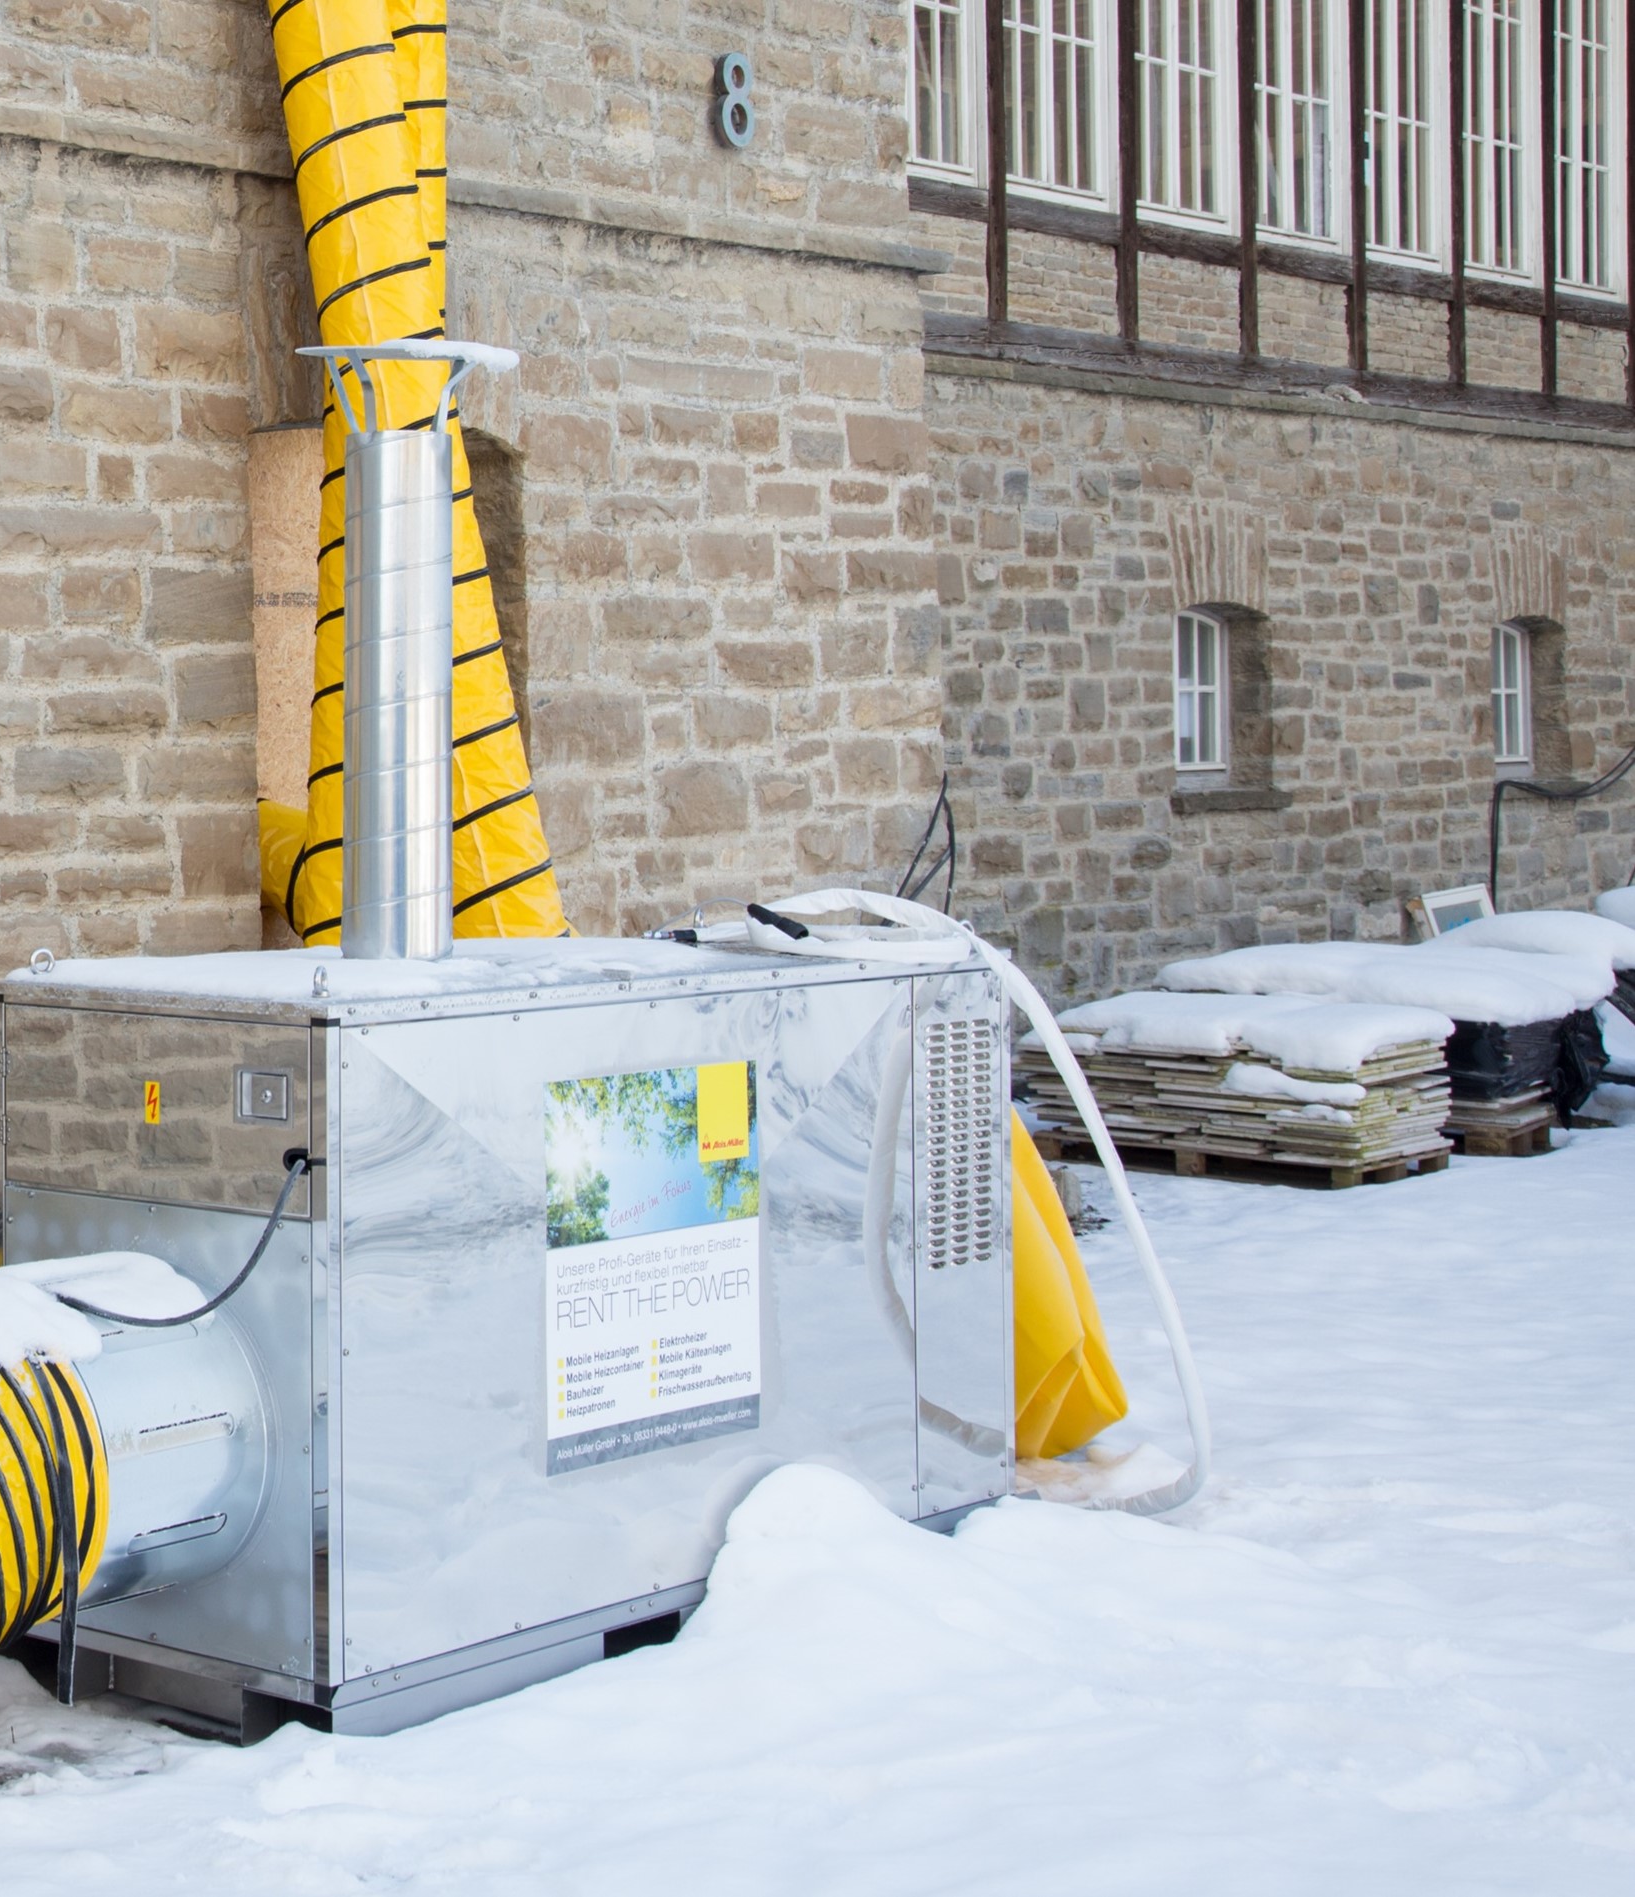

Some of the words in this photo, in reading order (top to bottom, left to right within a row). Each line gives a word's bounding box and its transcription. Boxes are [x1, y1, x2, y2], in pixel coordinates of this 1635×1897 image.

[720, 52, 756, 148] 8
[610, 1204, 647, 1229] Energie
[647, 1195, 660, 1210] im
[661, 1179, 692, 1202] Fokus
[556, 1263, 596, 1279] Unsere
[598, 1249, 662, 1273] Profi-Geräte
[663, 1245, 678, 1260] für
[679, 1242, 706, 1257] Ihren
[707, 1236, 742, 1254] Einsatz
[556, 1276, 609, 1298] kurzfristig
[611, 1271, 632, 1288] und
[634, 1265, 670, 1283] flexibel
[671, 1258, 709, 1276] mietbar
[556, 1291, 619, 1331] RENT
[622, 1283, 668, 1318] THE
[672, 1267, 751, 1310] POWER
[659, 1331, 708, 1349] Elektroheizer
[565, 1353, 593, 1368] Mobile
[593, 1344, 640, 1363] Heizanlagen
[658, 1351, 684, 1365] Mobile
[684, 1342, 732, 1360] Kälteanlagen
[566, 1370, 593, 1384] Mobile
[593, 1360, 645, 1379] Heizcontainer
[658, 1364, 703, 1381] Klimageräte
[658, 1370, 753, 1398] Frischwasseraufbereitung
[566, 1384, 605, 1402] Bauheizer
[566, 1398, 616, 1418] Heizpatronen
[556, 1447, 574, 1461] Alois
[573, 1442, 594, 1457] Müller
[595, 1436, 617, 1451] GmbH
[621, 1432, 632, 1445] Tel.
[633, 1427, 653, 1442] 08331
[682, 1408, 752, 1431] www.alois-mueller.com
